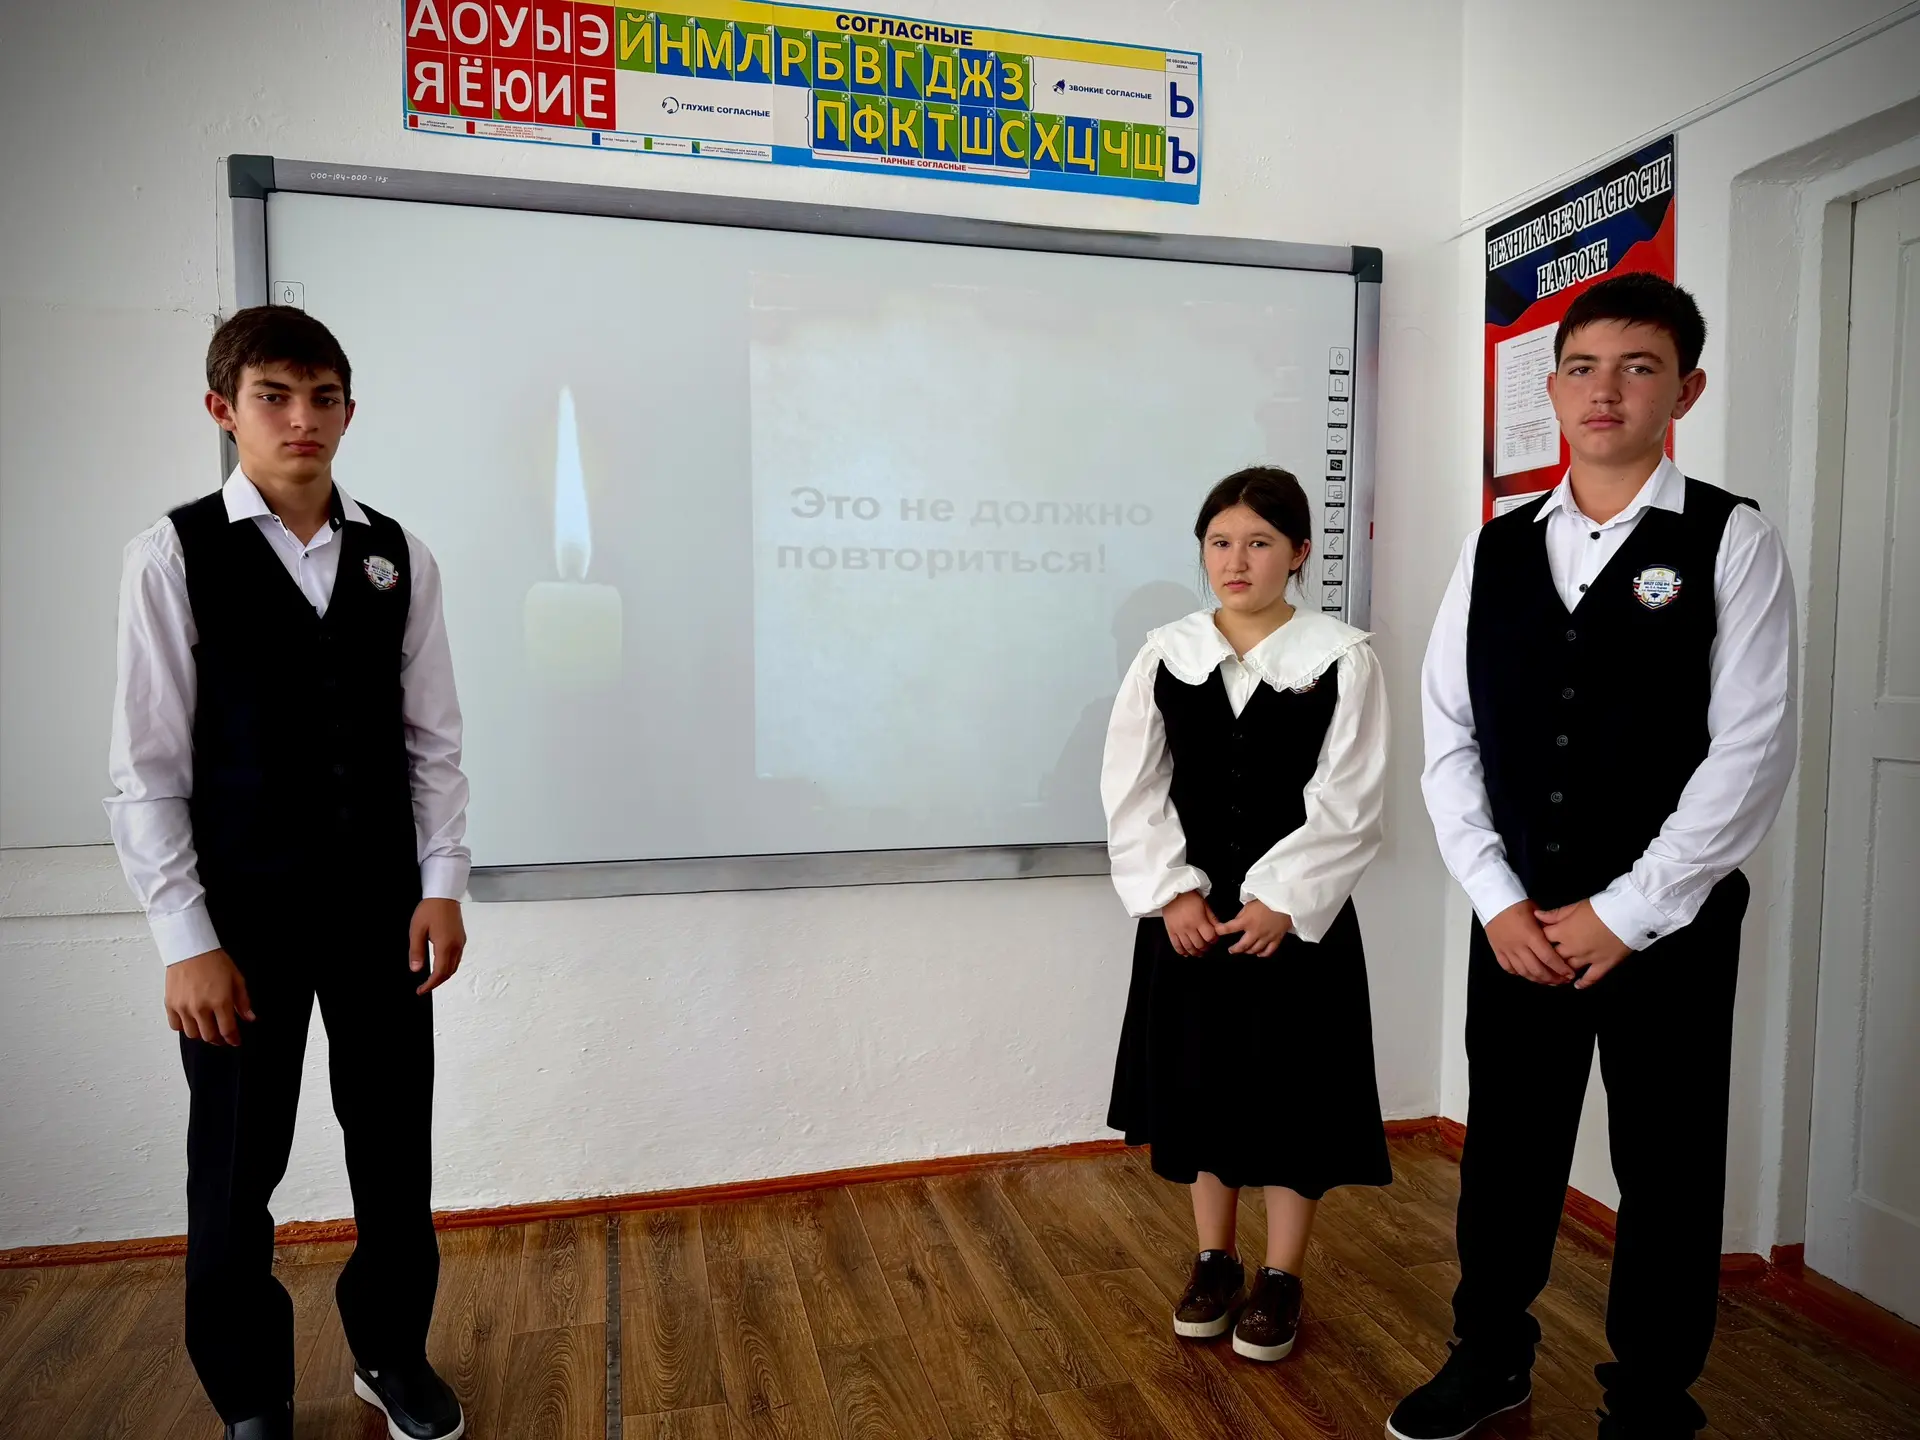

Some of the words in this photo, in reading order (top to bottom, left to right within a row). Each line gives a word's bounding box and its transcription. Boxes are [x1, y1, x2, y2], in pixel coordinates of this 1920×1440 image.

[835, 14, 974, 46] СОГЛАСНЫЕ
[680, 102, 715, 114] ГЛУХИЕ
[716, 106, 771, 118] СОГЛАСНЫЕ
[1068, 84, 1104, 95] ЗВОНКИЕ
[1105, 88, 1152, 101] СОГЛАСНЫЕ
[1169, 81, 1195, 119] Ь
[880, 156, 915, 167] ПАРНЫЕ
[916, 160, 967, 172] СОГЛАСНЫЕ
[1167, 135, 1196, 175] Ъ
[1488, 214, 1551, 271] ТЕХНИКА
[1550, 153, 1671, 242] БЕЗОПАСНОСТИ
[1537, 261, 1560, 299] НА
[1558, 238, 1608, 290] УРОКЕ
[789, 486, 881, 520] Это
[900, 497, 956, 522] не
[970, 498, 1154, 528] должно
[777, 543, 1107, 579] повториться!
